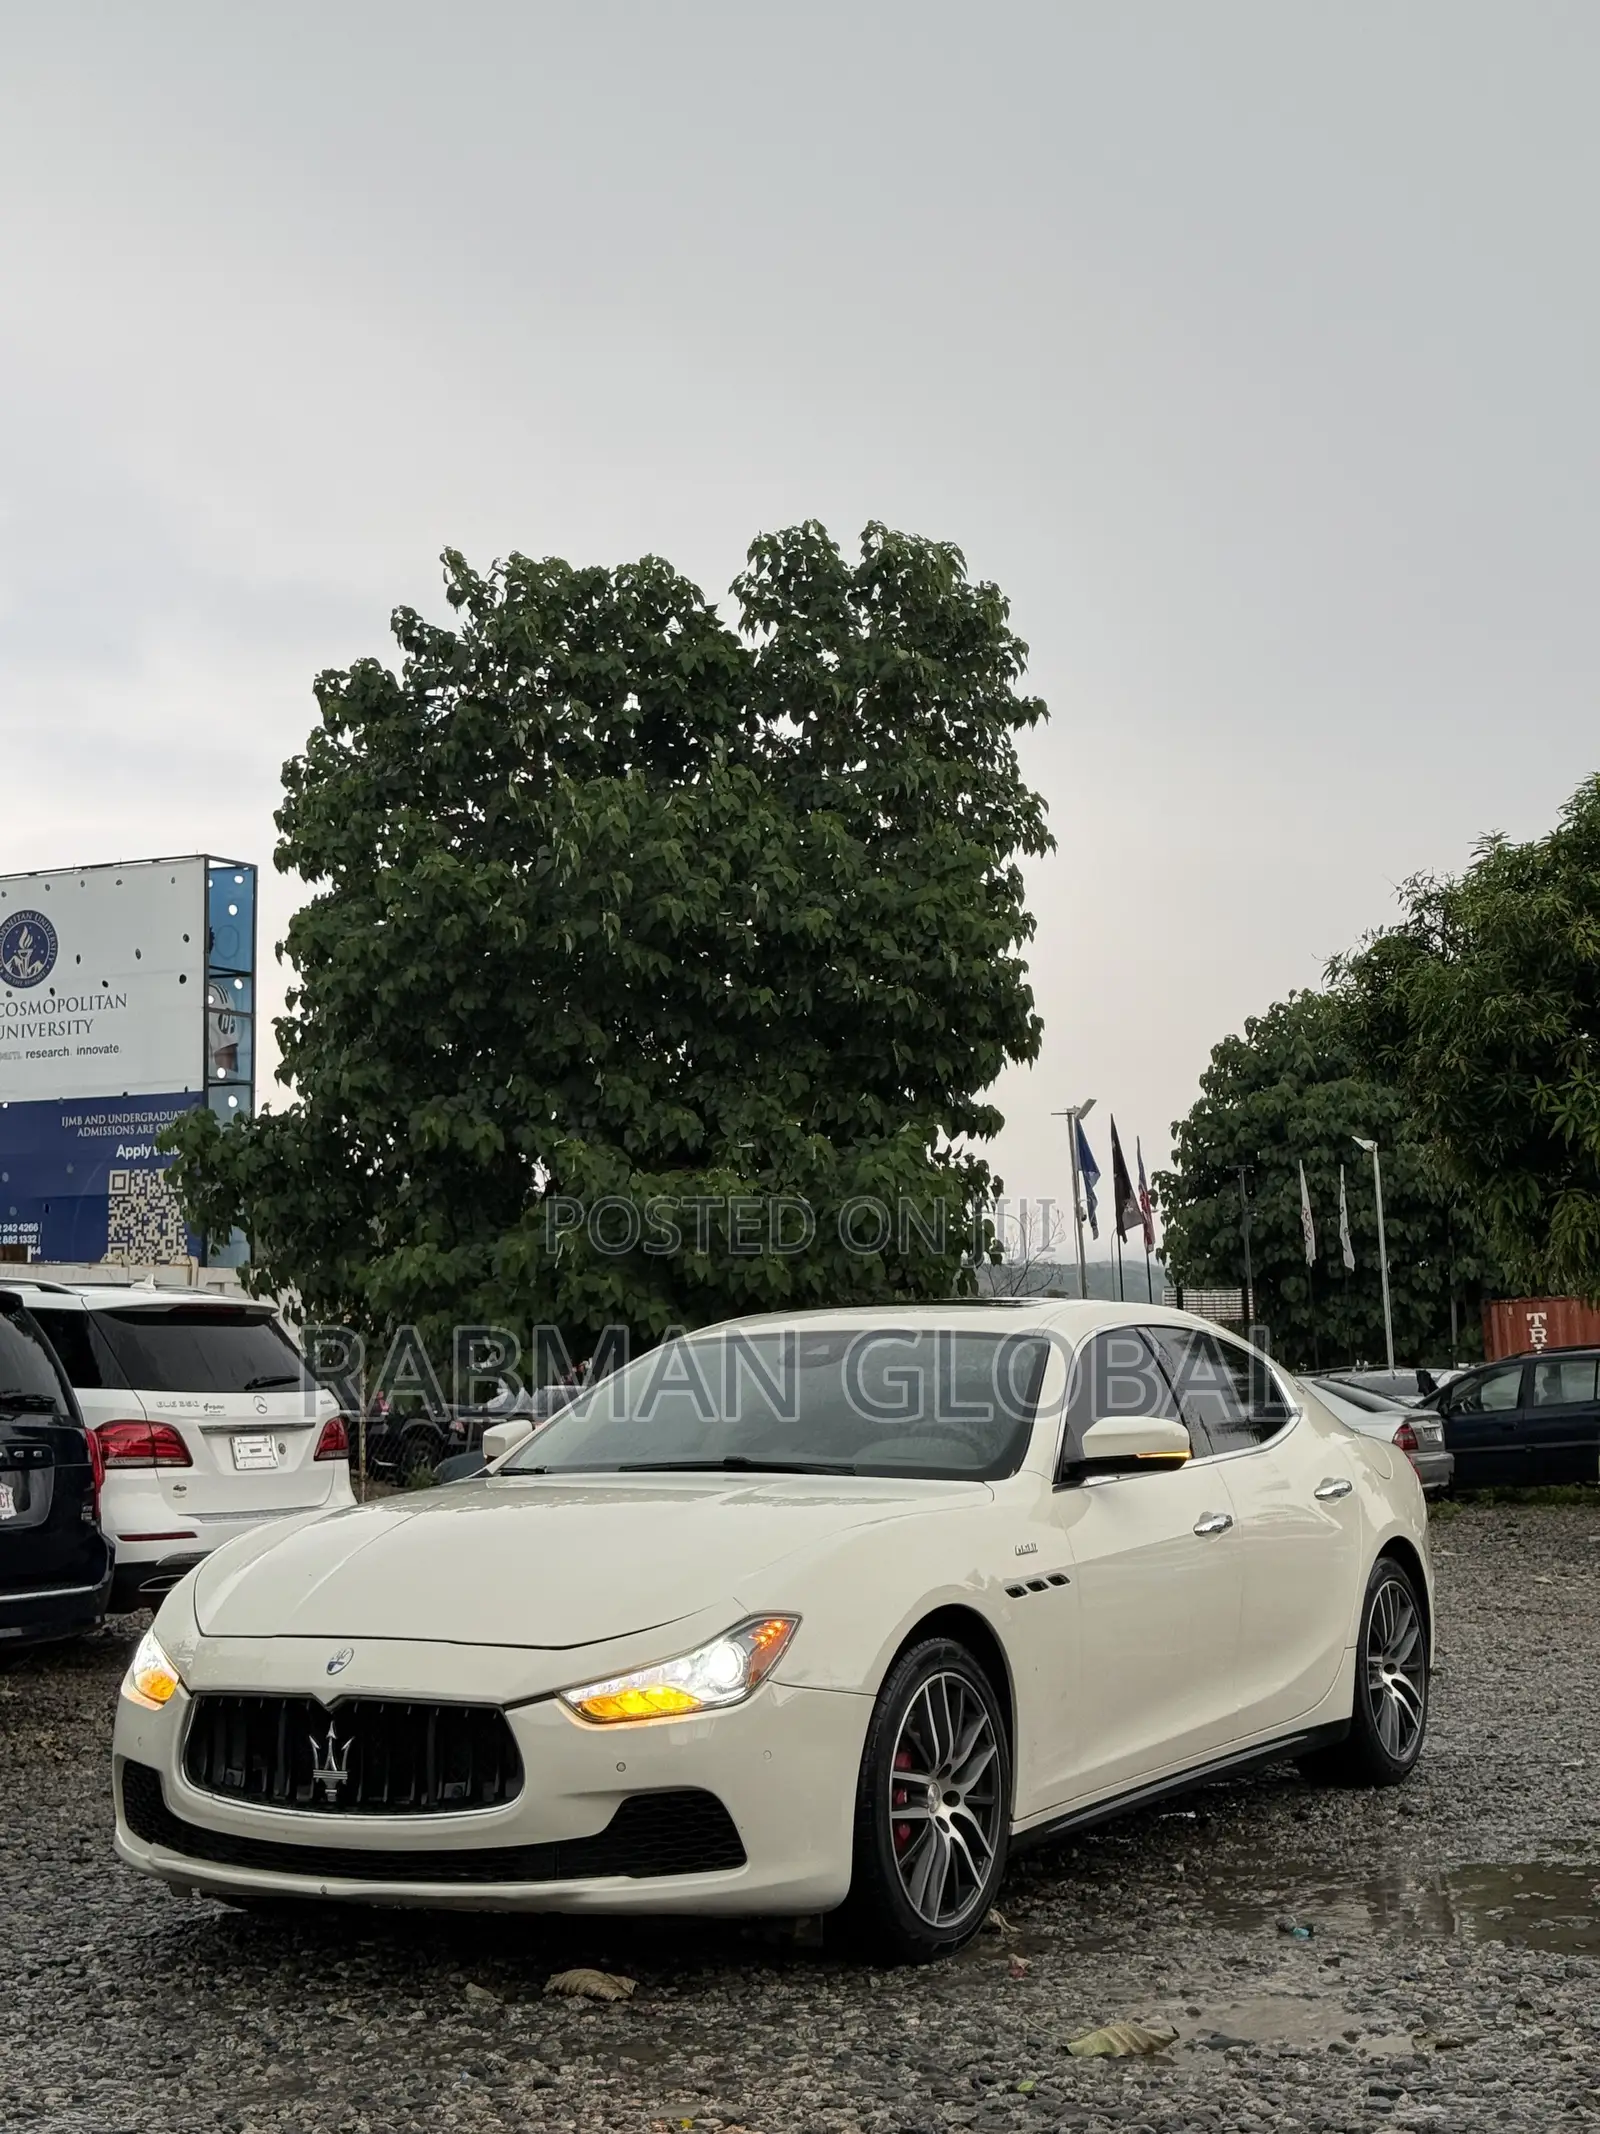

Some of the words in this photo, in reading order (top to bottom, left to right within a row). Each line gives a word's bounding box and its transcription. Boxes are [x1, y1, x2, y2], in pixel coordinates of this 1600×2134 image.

[61, 1116, 82, 1128] IJMB
[84, 1114, 106, 1125] AND
[77, 1125, 135, 1137] ADMISSIONS
[136, 1123, 154, 1134] ARE
[115, 1144, 151, 1160] Apply
